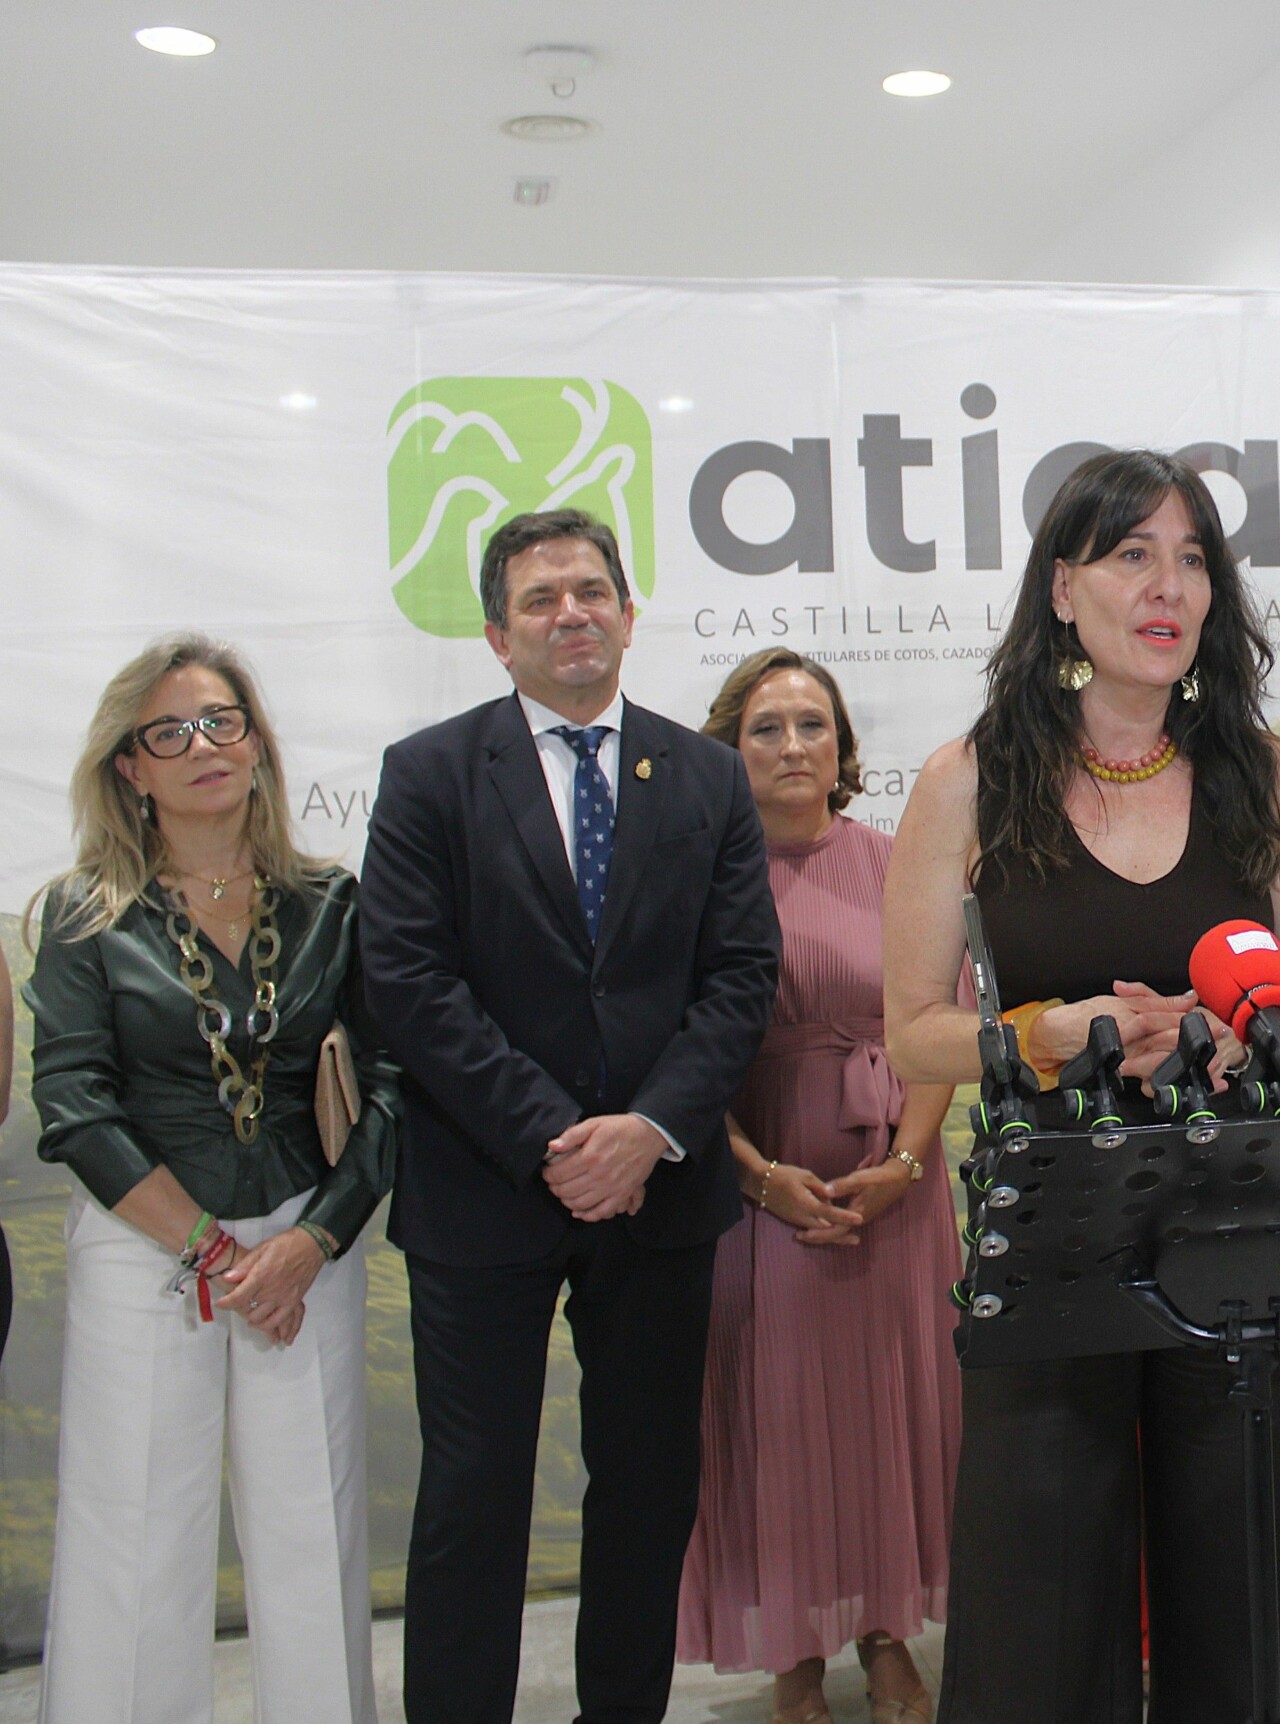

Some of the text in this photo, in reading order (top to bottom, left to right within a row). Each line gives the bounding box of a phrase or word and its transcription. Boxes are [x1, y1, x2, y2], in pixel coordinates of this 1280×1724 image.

[694, 605, 950, 638] CASTILLA
[700, 653, 747, 665] ASOCIA
[874, 650, 890, 661] DE
[894, 649, 938, 661] COTOS,
[942, 647, 993, 659] CAZADO
